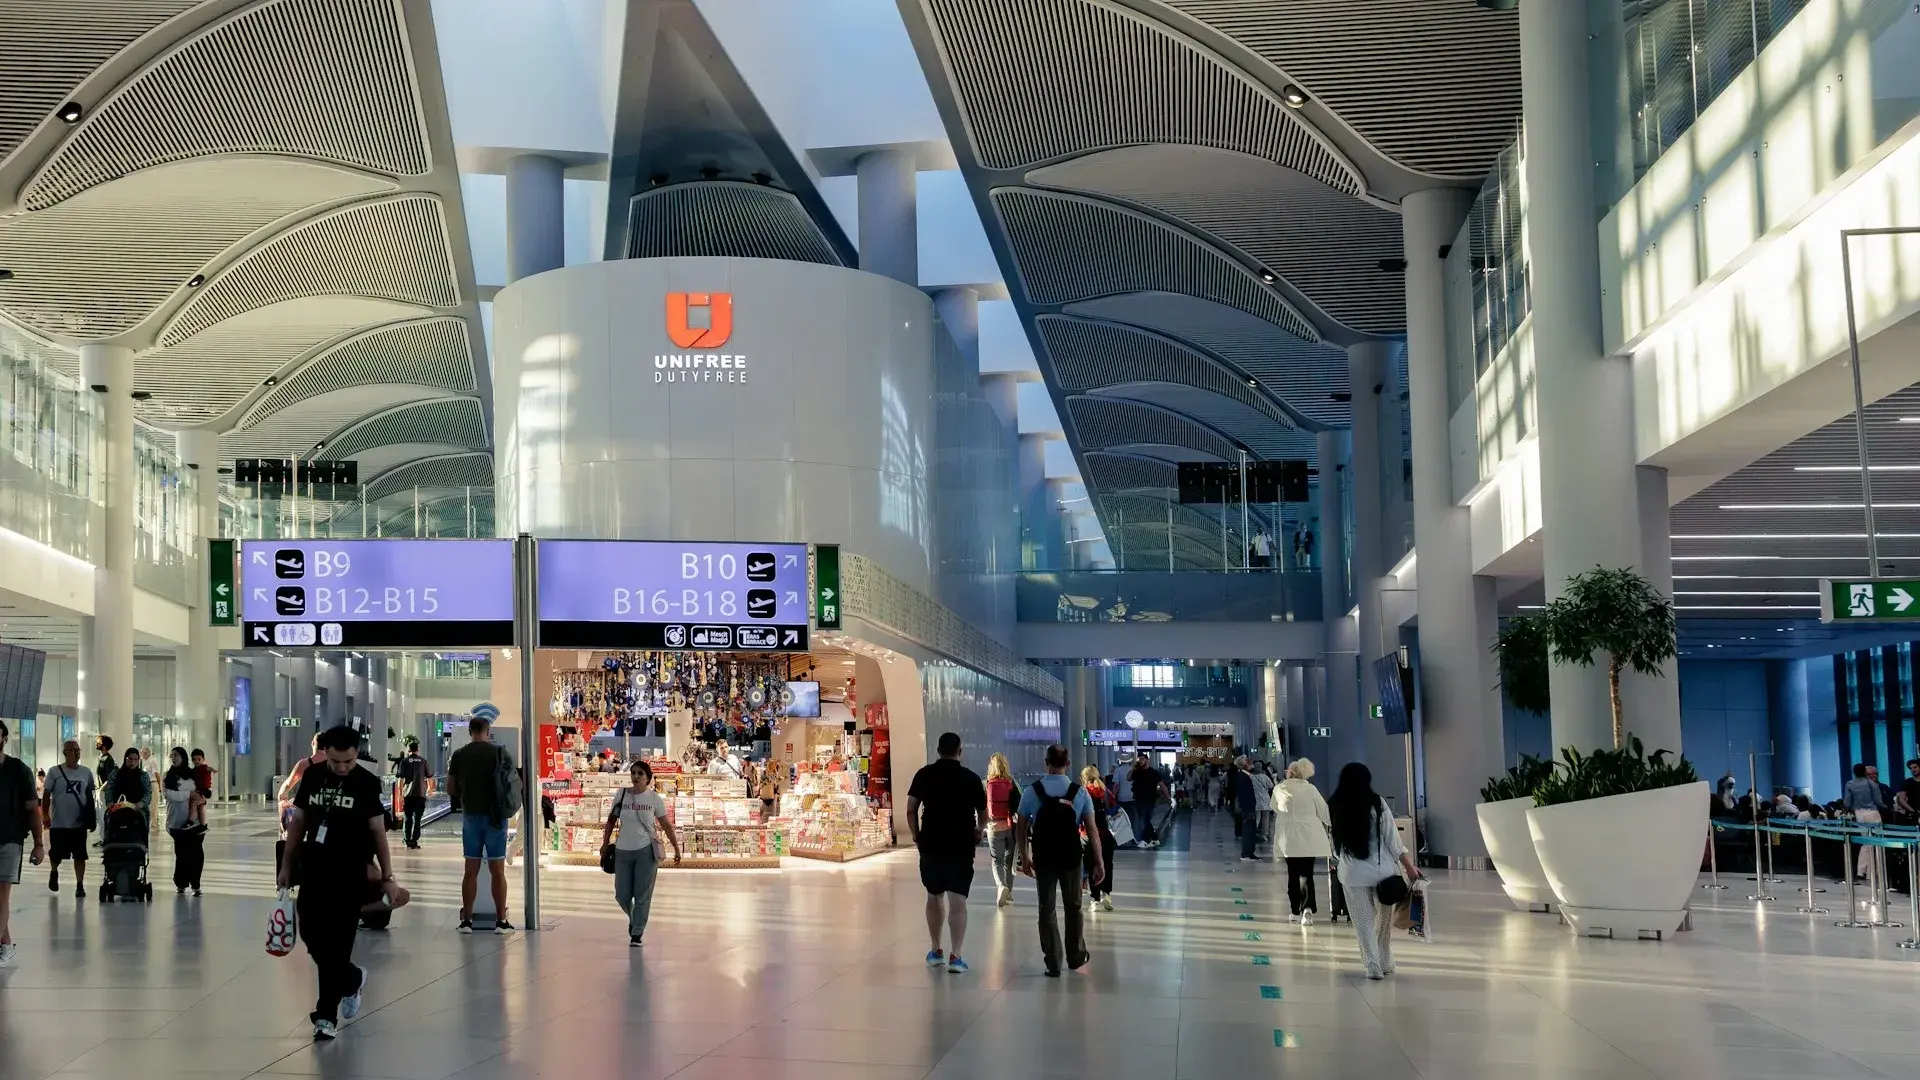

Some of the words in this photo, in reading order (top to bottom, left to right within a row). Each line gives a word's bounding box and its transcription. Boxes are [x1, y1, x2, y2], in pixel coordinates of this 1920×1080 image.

[654, 354, 746, 368] UNIFREE
[654, 371, 747, 383] DUTYFREE
[313, 551, 351, 578] B9
[681, 552, 737, 580] B10
[315, 587, 439, 614] B12-B15
[614, 588, 737, 616] B16-B18
[710, 636, 728, 644] Masjid
[1102, 731, 1127, 739] B16-B18
[1156, 731, 1168, 739] B10
[1183, 746, 1228, 758] B16-B17
